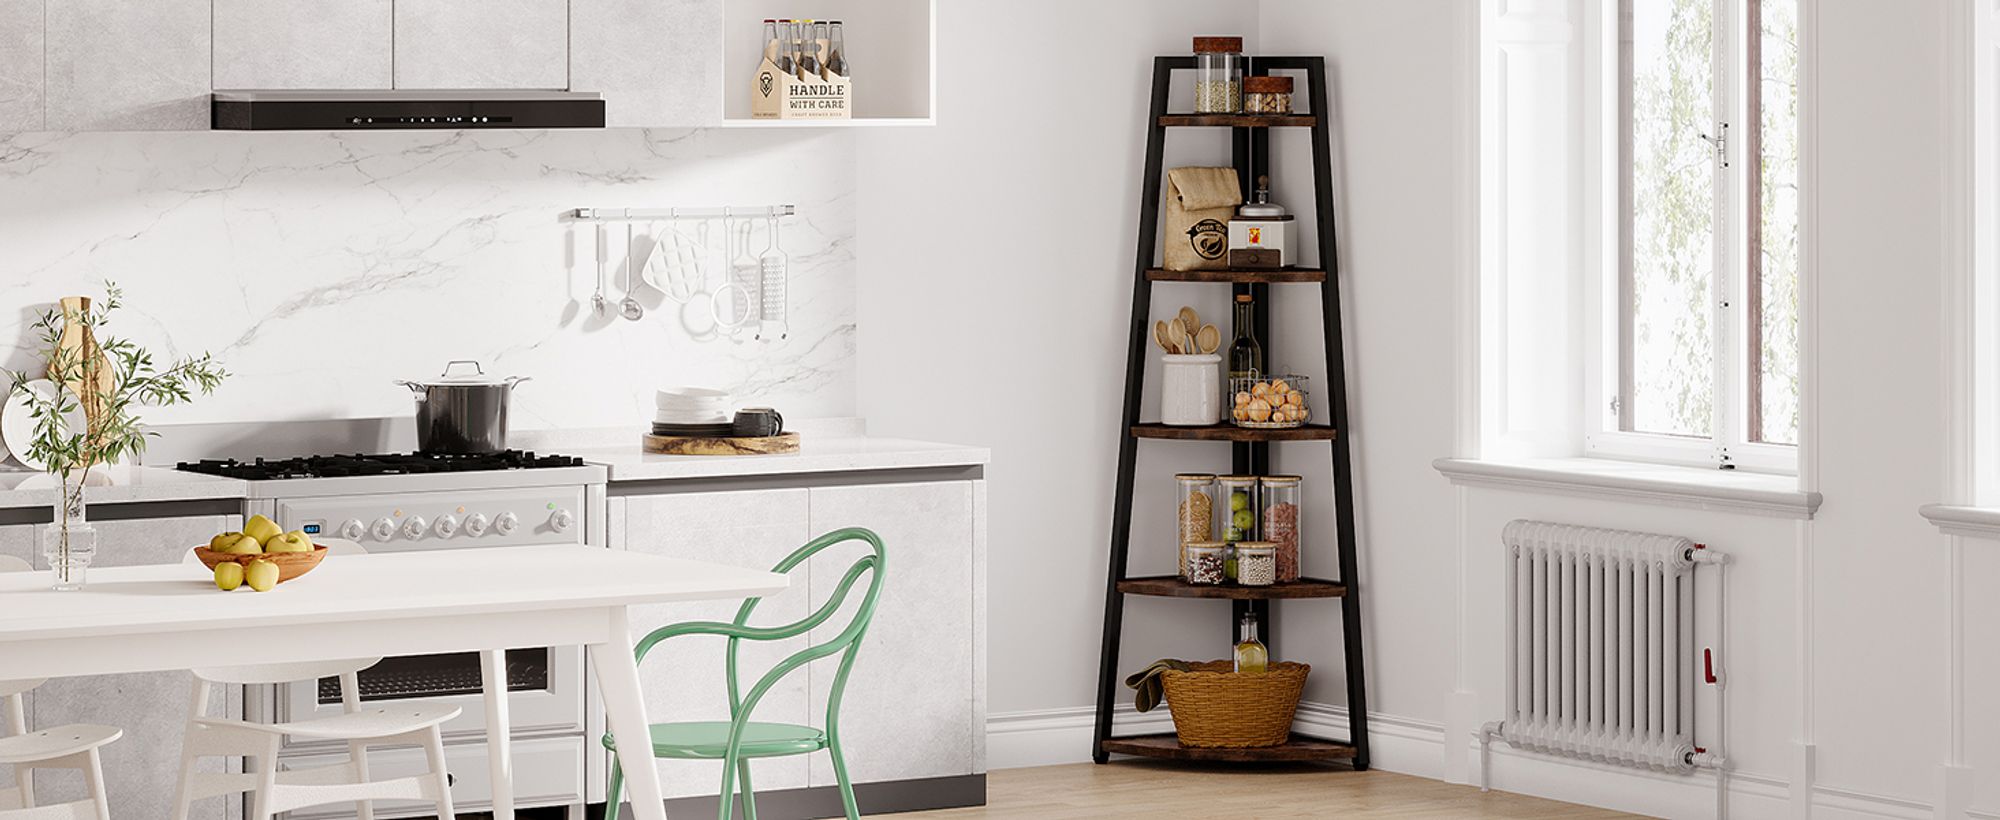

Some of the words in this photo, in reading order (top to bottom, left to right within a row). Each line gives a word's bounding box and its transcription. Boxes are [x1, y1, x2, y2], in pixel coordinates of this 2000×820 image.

[789, 85, 844, 96] HANDLE
[789, 101, 816, 109] WITH
[818, 101, 844, 109] CARE
